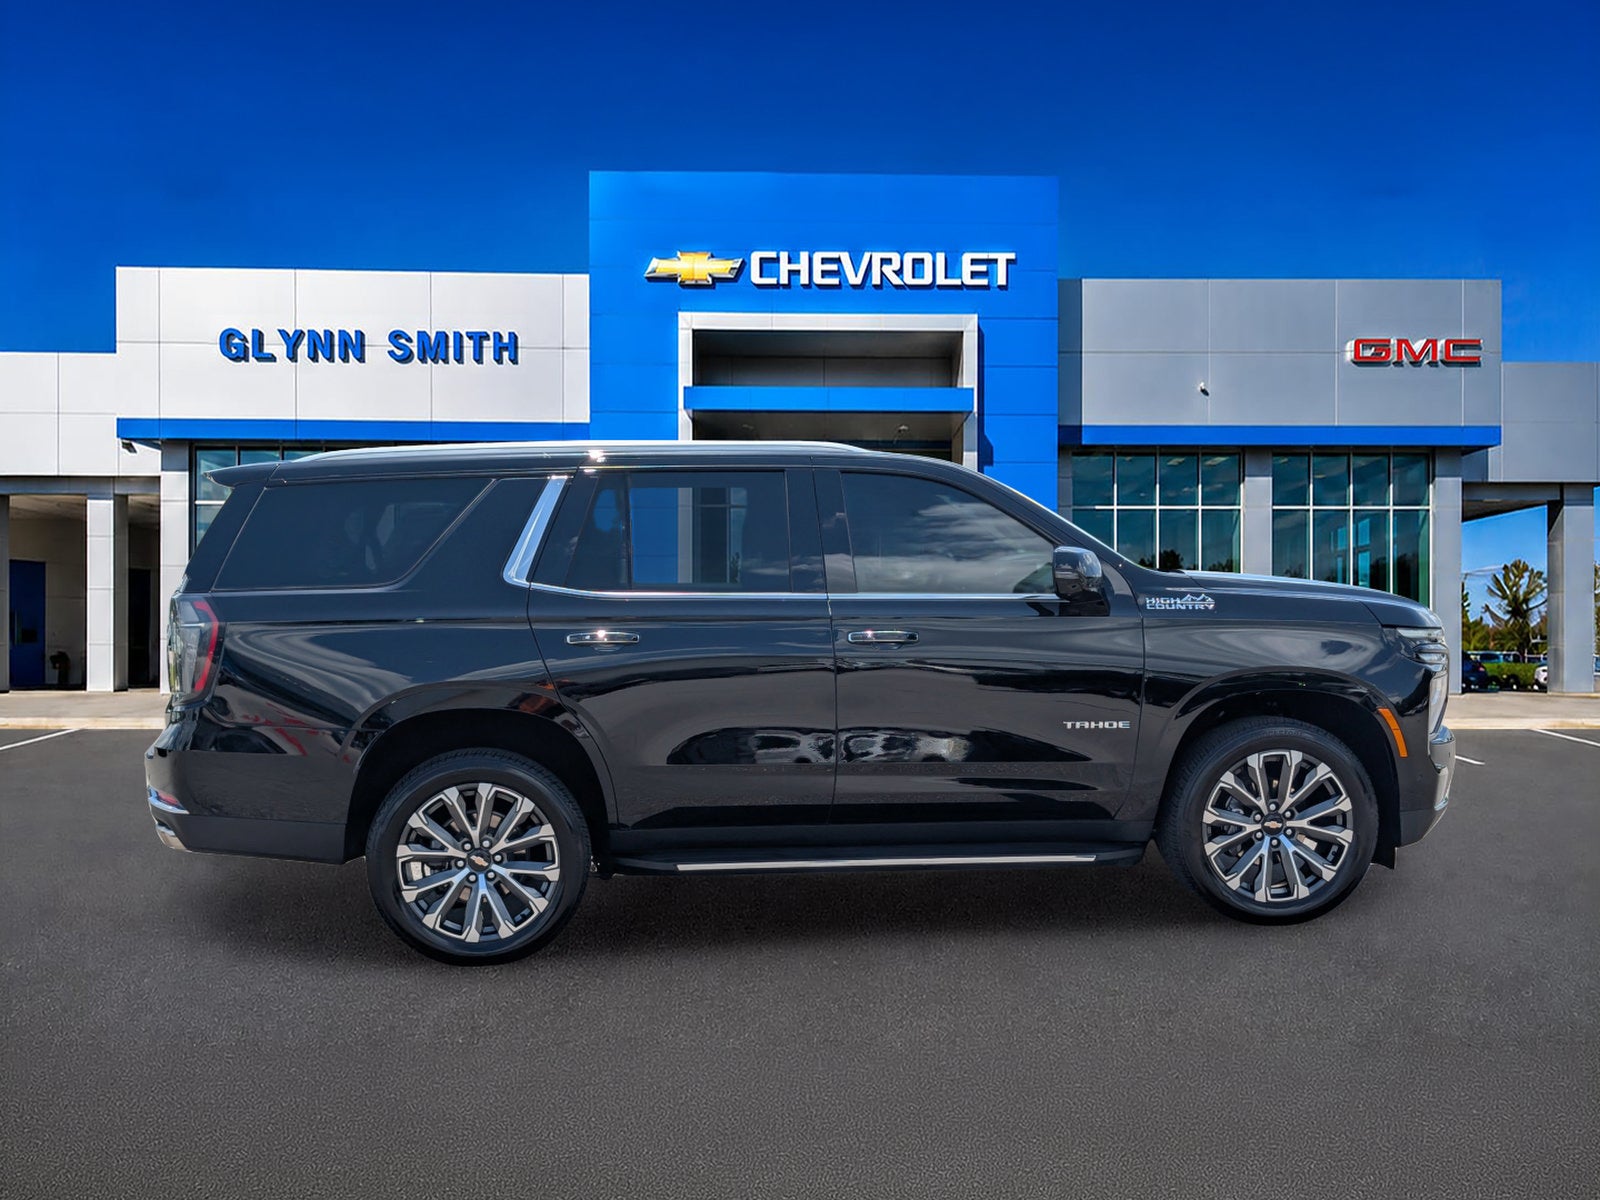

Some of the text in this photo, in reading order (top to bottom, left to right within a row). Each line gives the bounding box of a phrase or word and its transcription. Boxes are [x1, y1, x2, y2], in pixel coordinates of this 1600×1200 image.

[749, 250, 1016, 287] CHEVROLET
[219, 327, 518, 365] GLYNN SMITH
[1351, 338, 1482, 365] GMC
[1063, 720, 1131, 729] TAHOE
